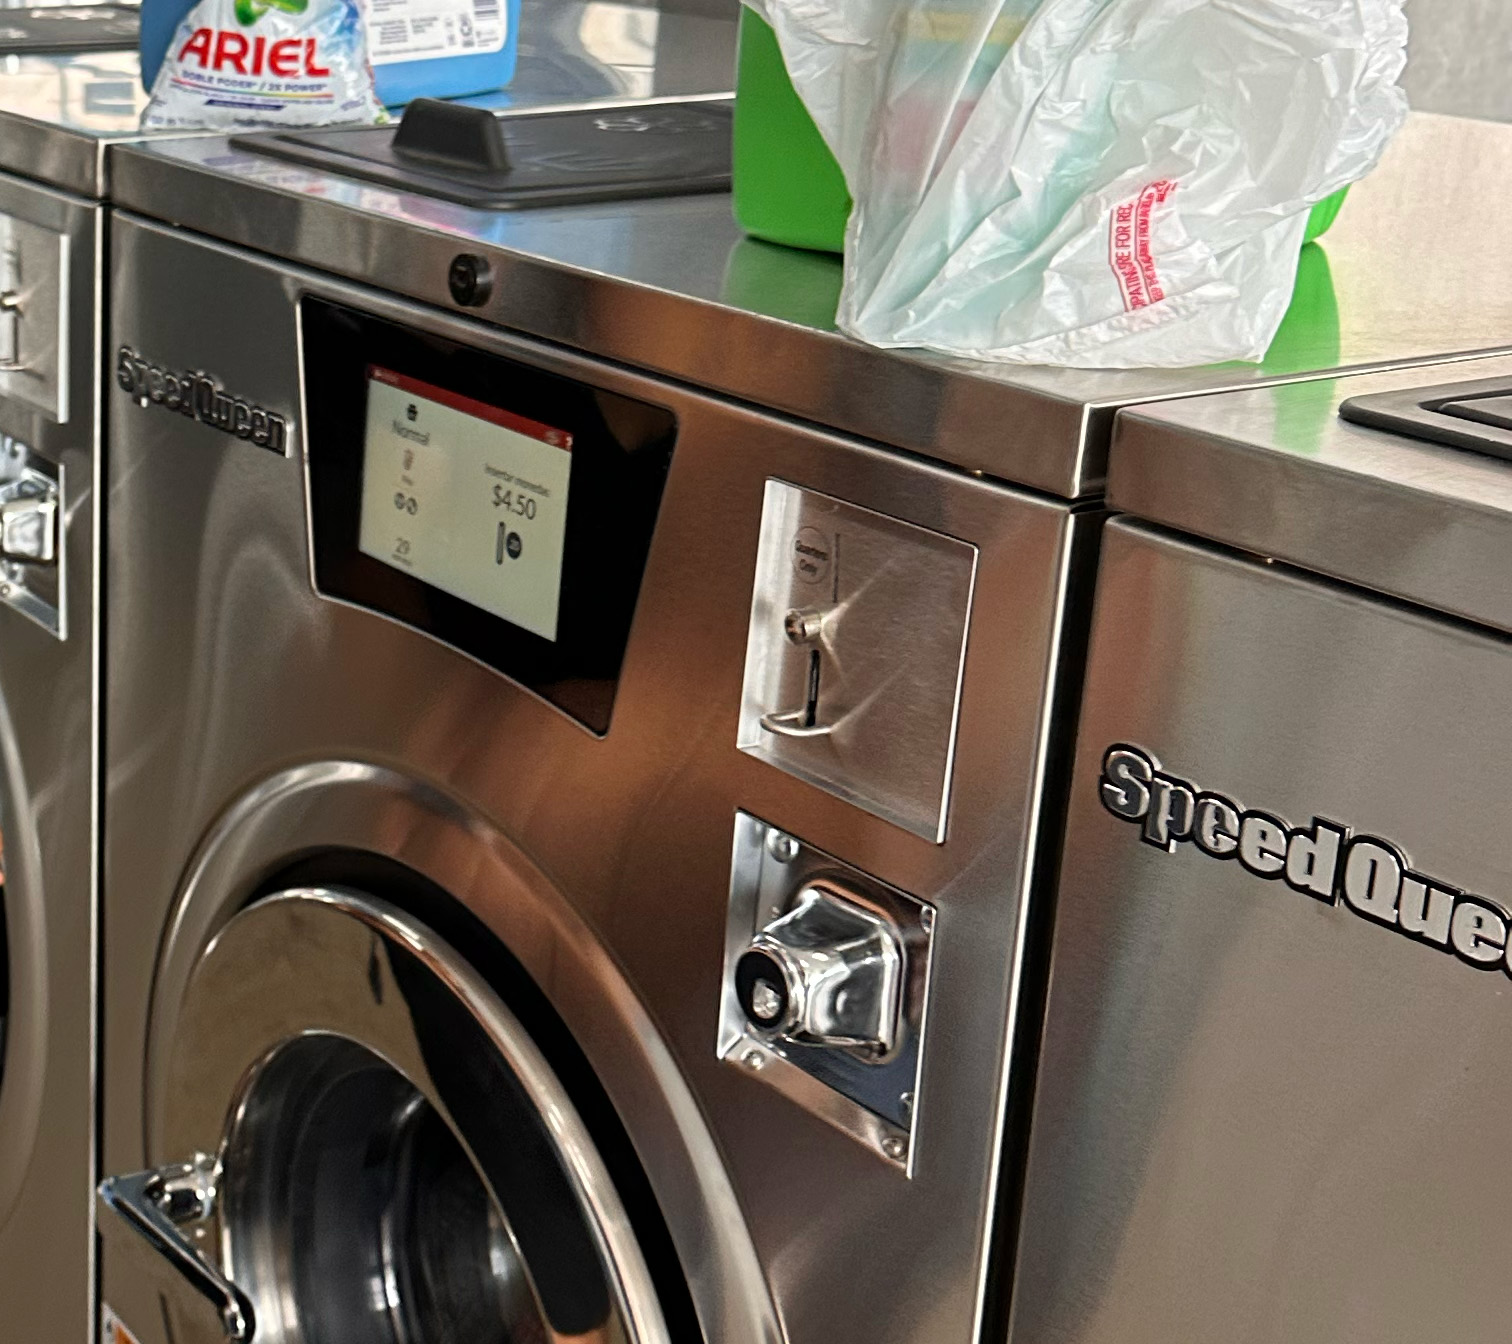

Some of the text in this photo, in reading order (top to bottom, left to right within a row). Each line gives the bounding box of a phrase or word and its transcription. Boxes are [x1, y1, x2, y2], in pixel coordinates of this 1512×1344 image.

[177, 27, 331, 79] ARIEL
[1115, 225, 1132, 249] FOR
[491, 484, 537, 521] $4.50
[1098, 742, 1512, 984] SpeedQue
